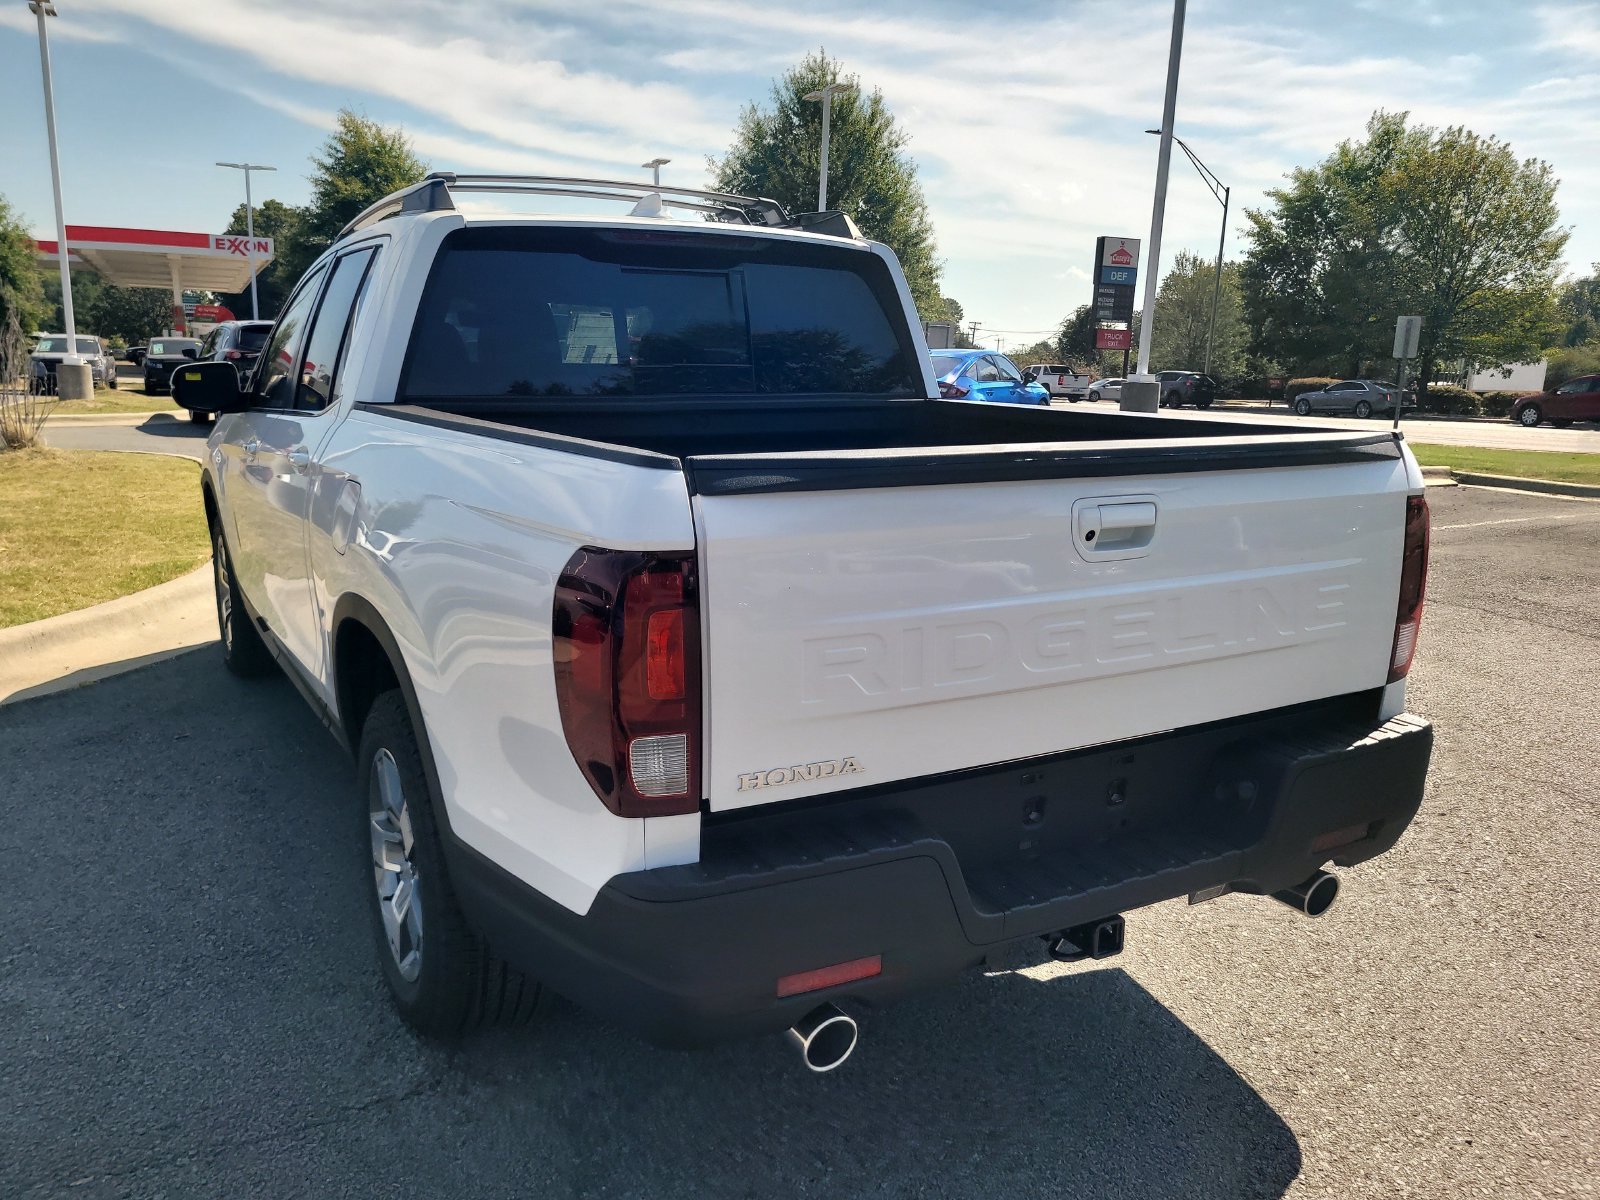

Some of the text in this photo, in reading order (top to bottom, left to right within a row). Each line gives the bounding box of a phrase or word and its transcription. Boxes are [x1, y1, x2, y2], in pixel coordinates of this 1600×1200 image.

[215, 238, 269, 256] EXXON
[1111, 272, 1128, 281] DEF
[1104, 333, 1123, 341] TRUCK
[801, 577, 1351, 704] RIDGELINE
[738, 757, 866, 792] HONDA
